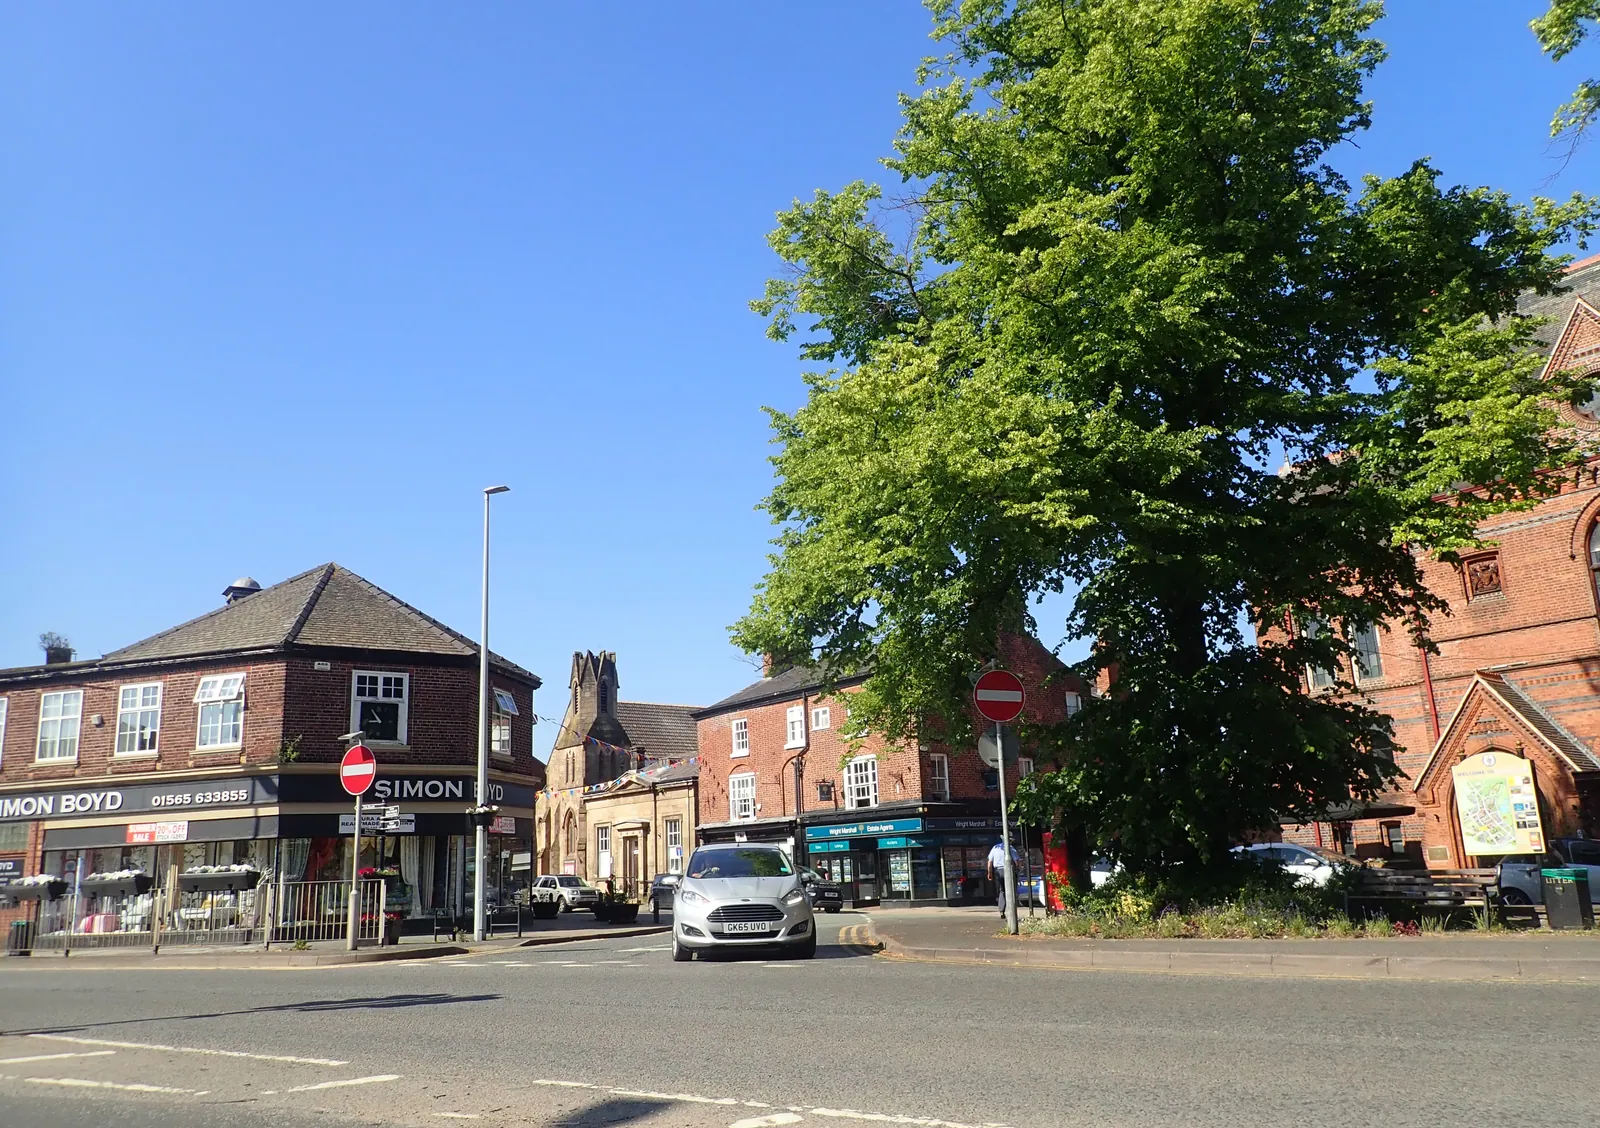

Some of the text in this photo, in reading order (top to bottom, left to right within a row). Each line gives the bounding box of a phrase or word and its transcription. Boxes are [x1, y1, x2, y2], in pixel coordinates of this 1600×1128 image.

[374, 780, 504, 801] SIMON BYD
[60, 791, 123, 813] BOYD
[152, 789, 248, 807] 01565 633855
[173, 824, 186, 834] OFF
[829, 828, 842, 836] Wright
[879, 824, 894, 832] Agents
[133, 833, 150, 841] SALE
[727, 922, 766, 931] GK65 UVO
